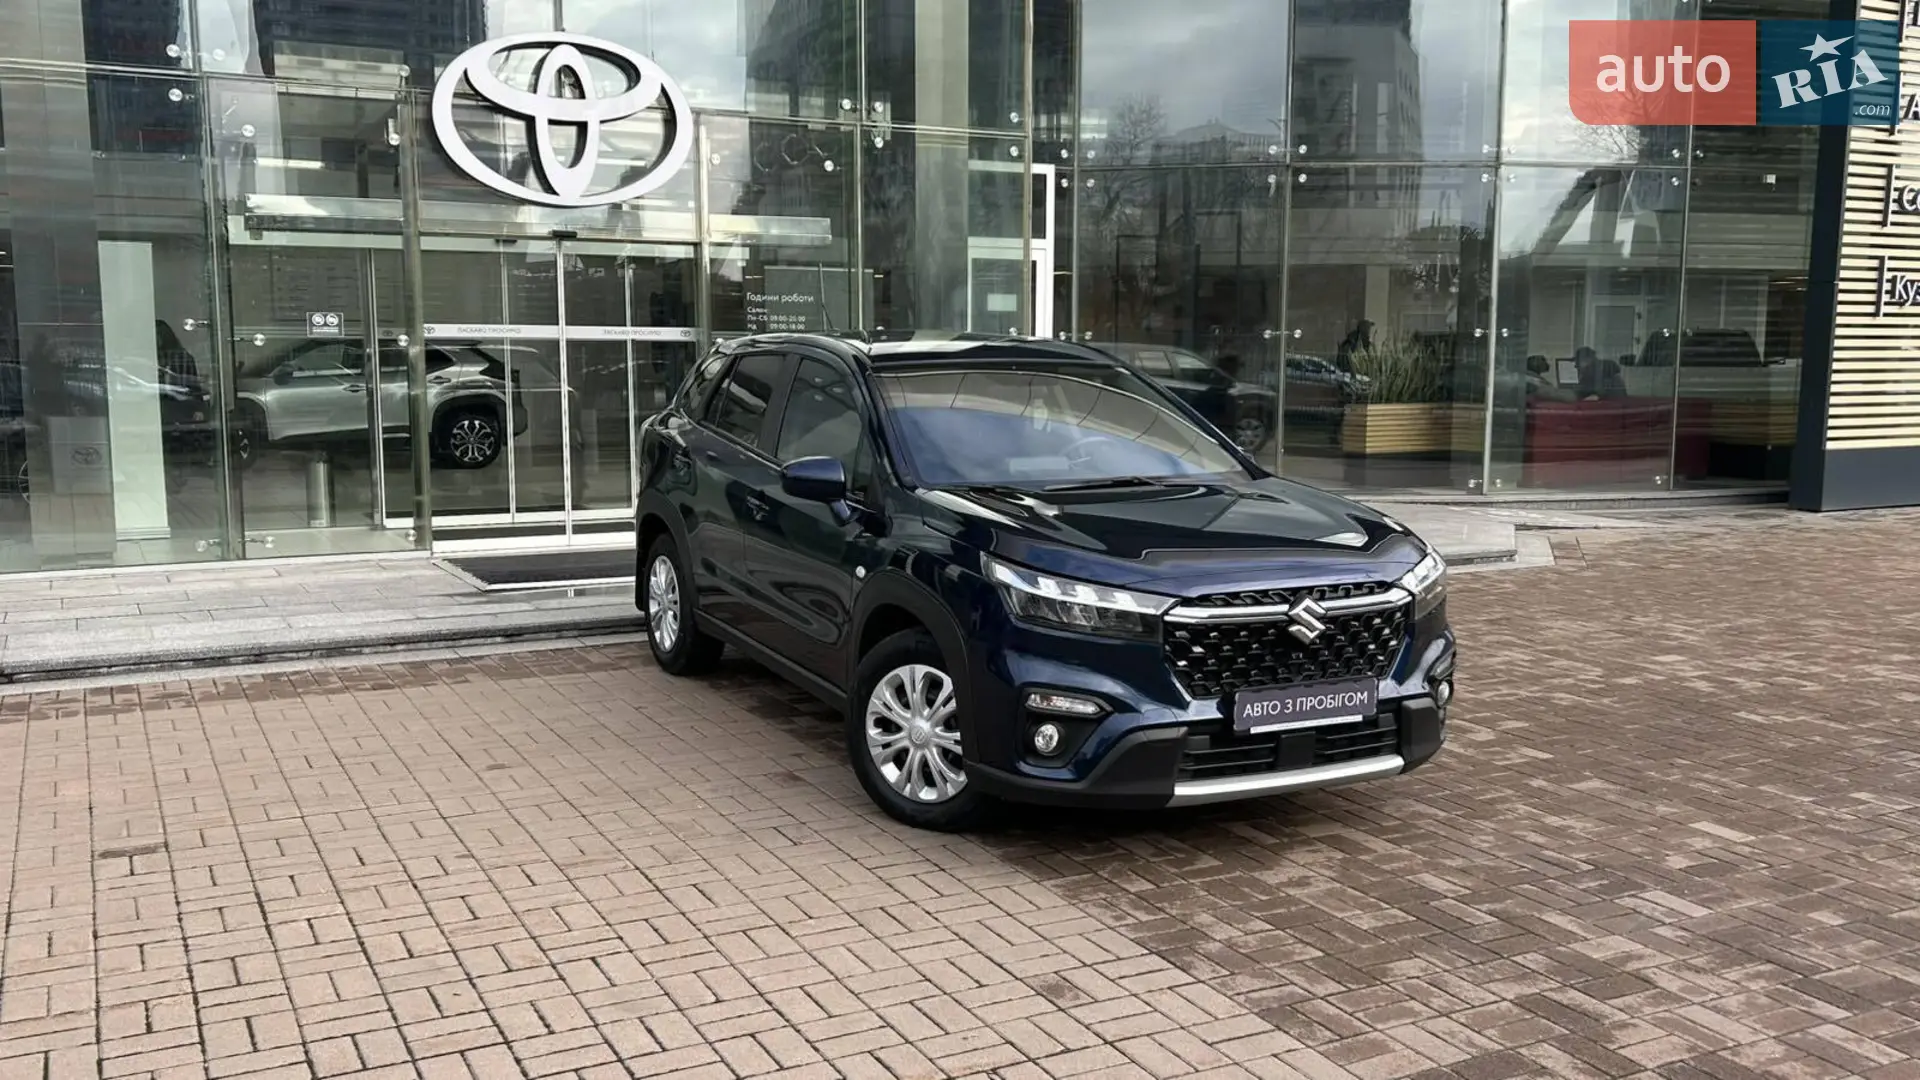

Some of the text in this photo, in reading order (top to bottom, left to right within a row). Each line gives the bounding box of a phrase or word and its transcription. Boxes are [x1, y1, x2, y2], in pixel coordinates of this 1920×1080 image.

[746, 292, 815, 304] Години роботи
[1242, 701, 1281, 718] АВТО
[1295, 691, 1369, 712] ПРОБІГОМ
